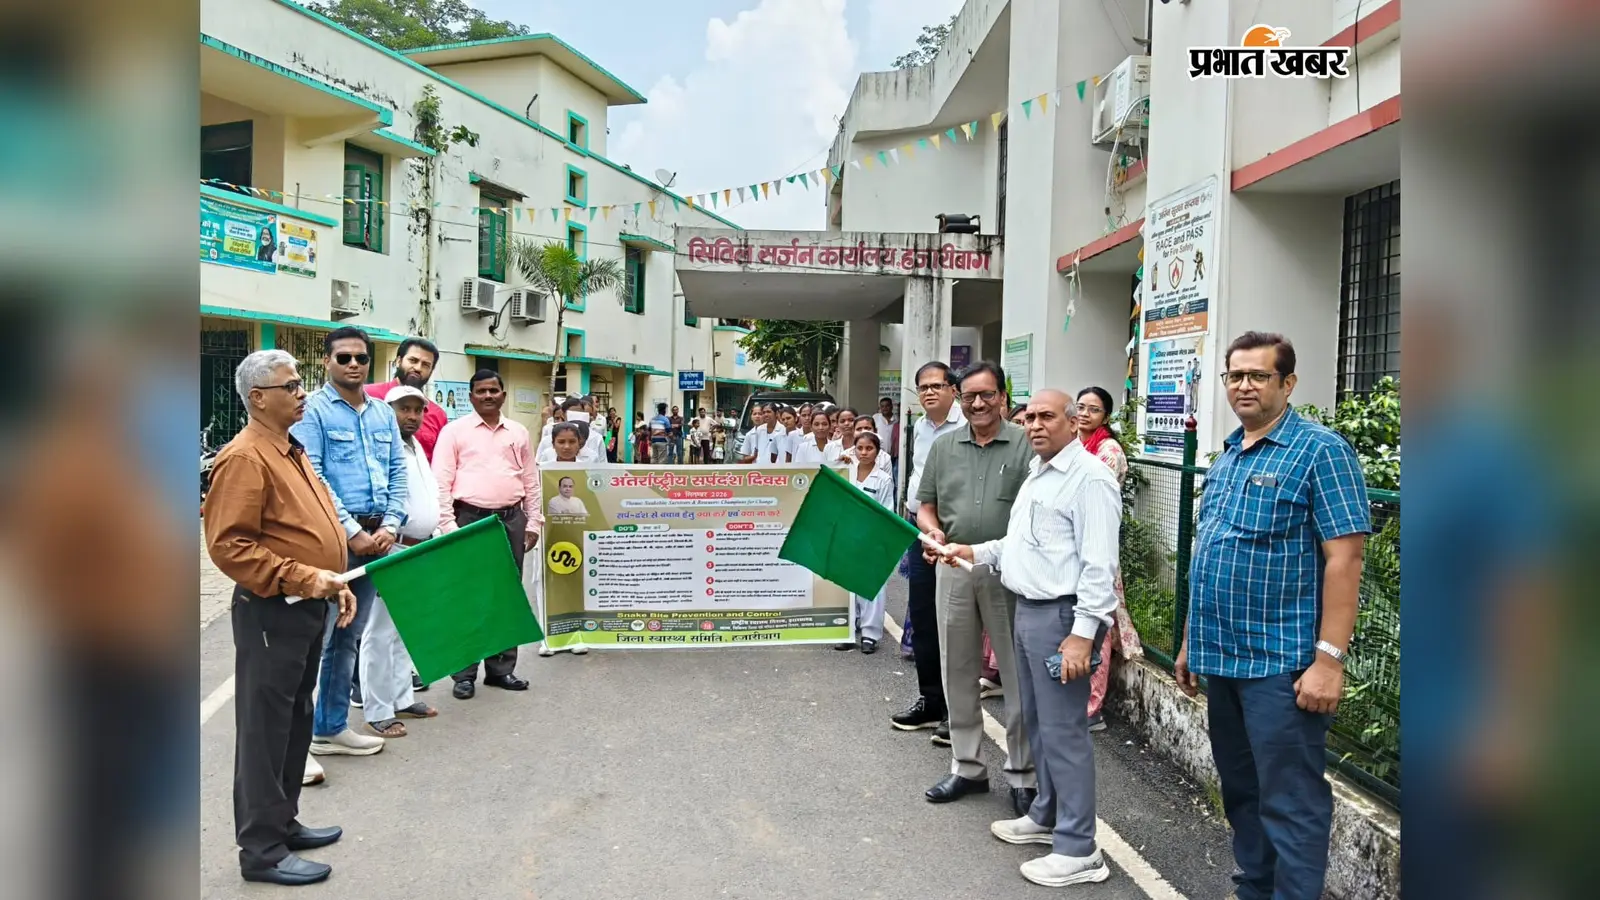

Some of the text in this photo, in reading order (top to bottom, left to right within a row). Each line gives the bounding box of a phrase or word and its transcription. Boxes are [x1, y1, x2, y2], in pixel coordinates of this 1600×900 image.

[1155, 236, 1173, 252] RACE
[1173, 231, 1185, 245] and
[1186, 225, 1204, 241] PASS
[688, 236, 755, 266] सिविल
[758, 237, 815, 267] सर्जन
[900, 242, 992, 271] हजारीबाग
[1162, 243, 1194, 258] for Fire Safety
[746, 471, 789, 486] दिवस
[651, 511, 658, 519] से
[682, 510, 695, 521] हेतु
[727, 509, 740, 518] एवं
[616, 633, 644, 643] जिला
